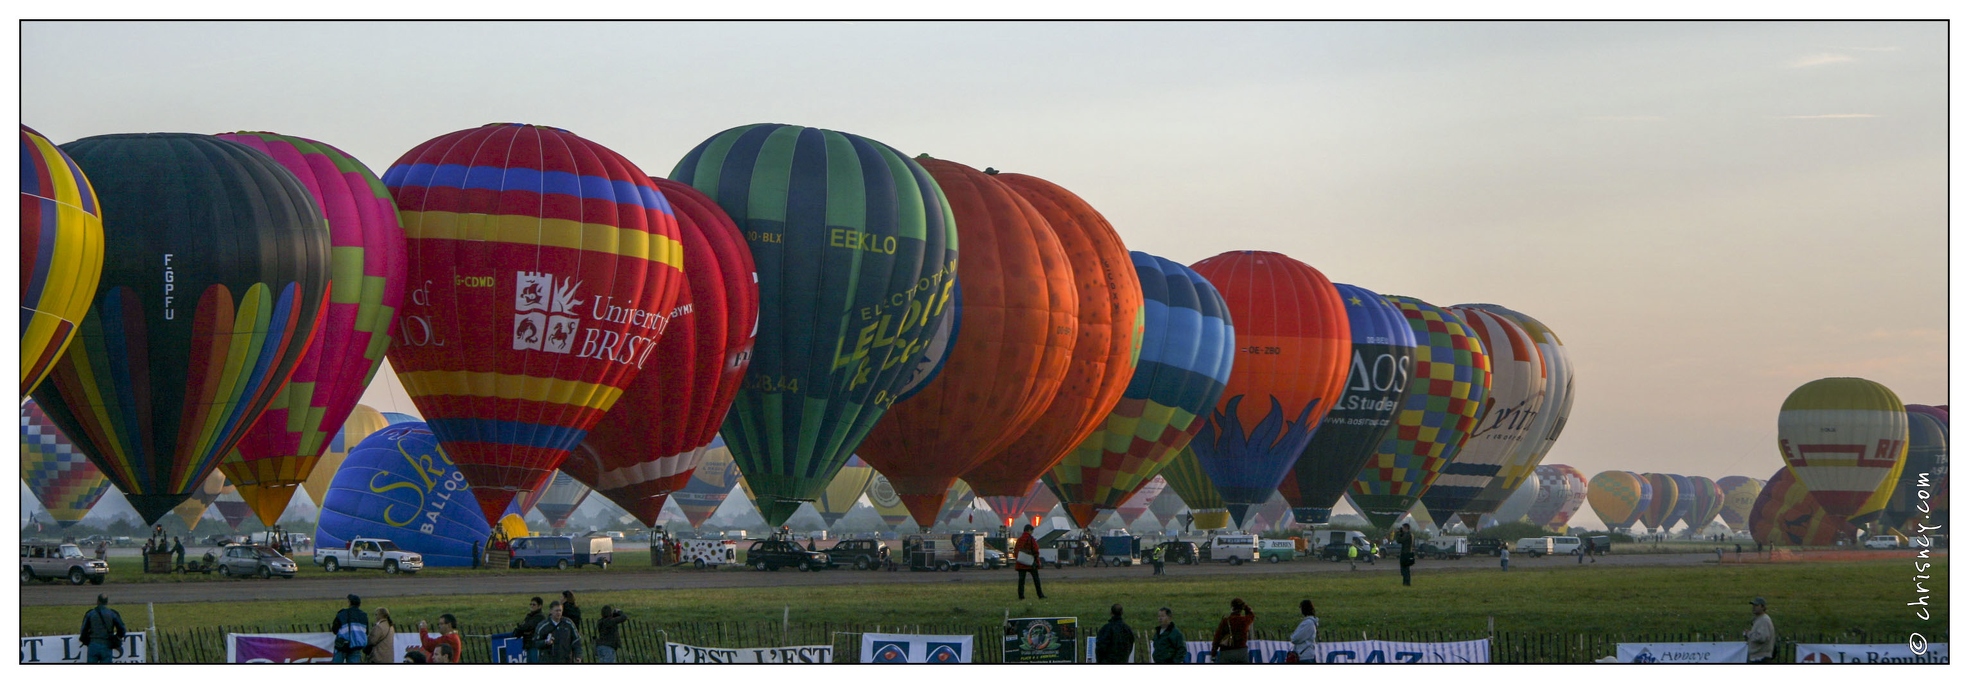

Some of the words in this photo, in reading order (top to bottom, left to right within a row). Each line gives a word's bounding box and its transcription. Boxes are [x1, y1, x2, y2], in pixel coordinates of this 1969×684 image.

[830, 228, 897, 255] EEKLO
[164, 253, 174, 320] F-GPFU
[412, 279, 432, 307] of
[455, 275, 495, 288] G-CDWD
[592, 294, 666, 339] Universty
[668, 644, 738, 663] L'EST
[753, 647, 831, 663] L'EST
